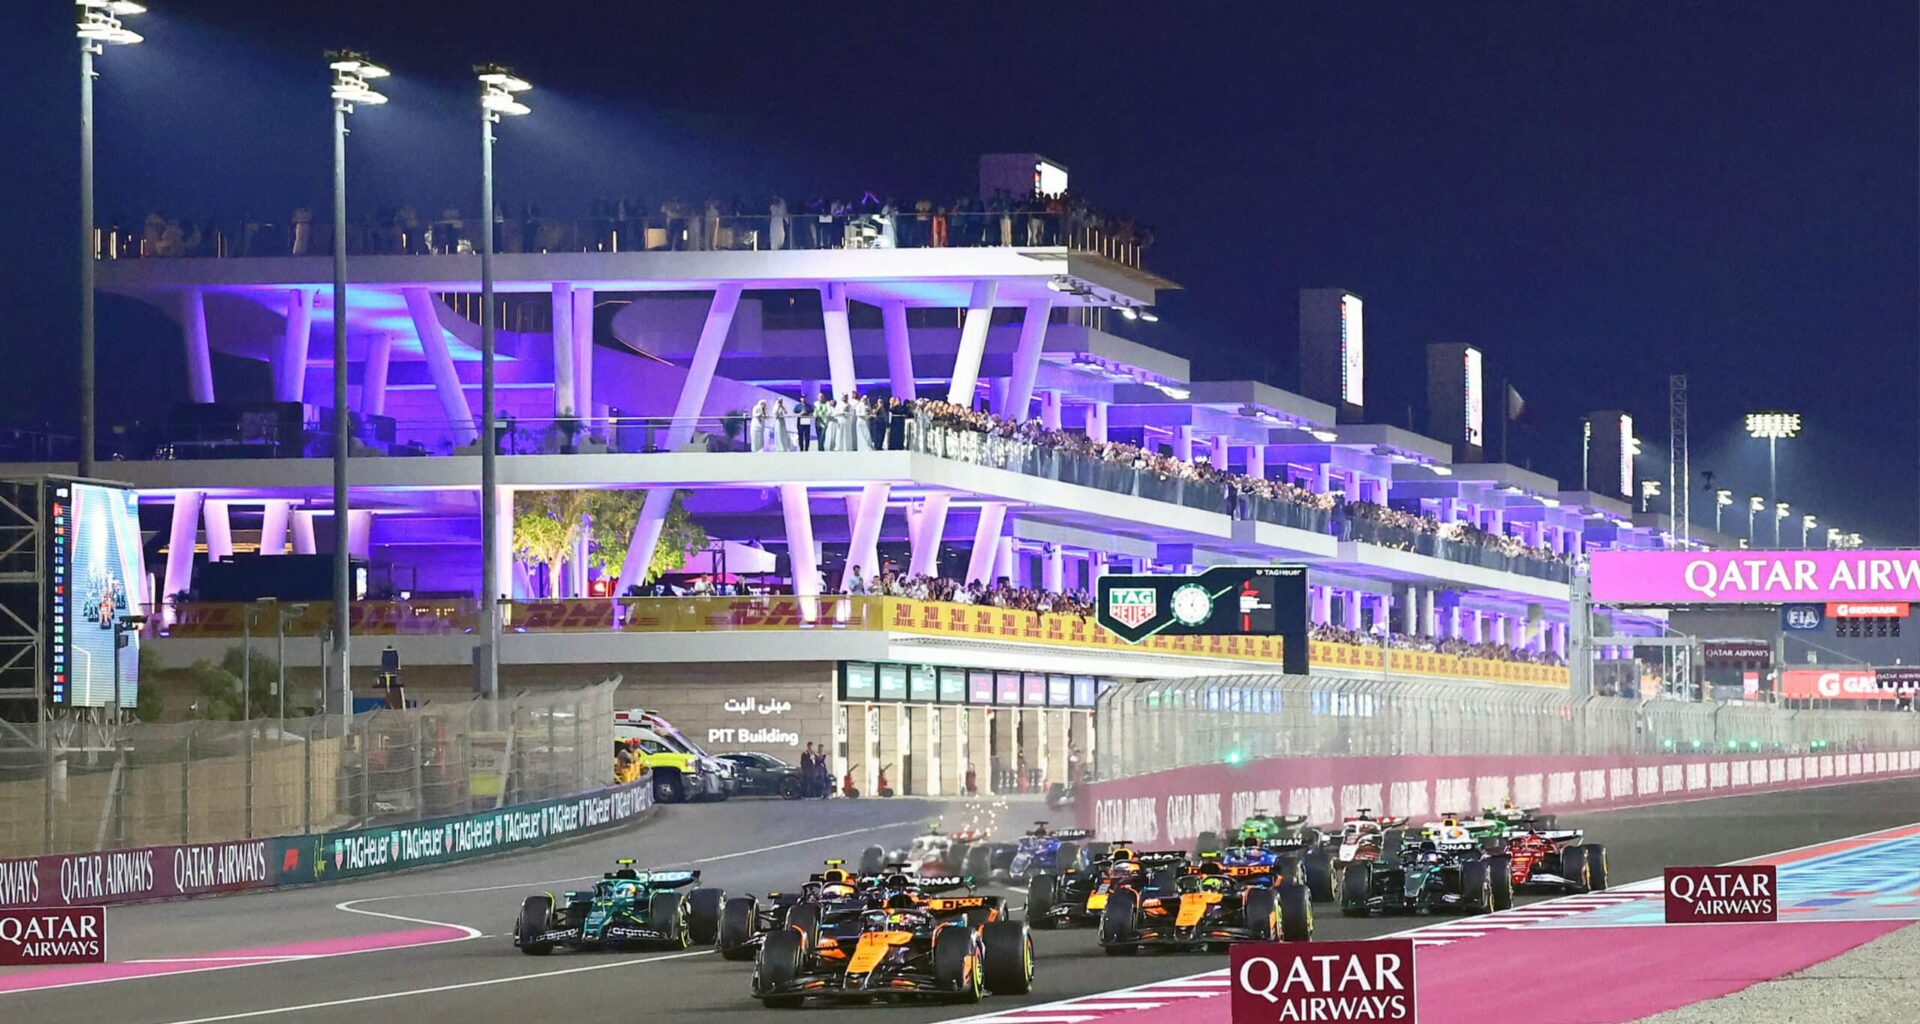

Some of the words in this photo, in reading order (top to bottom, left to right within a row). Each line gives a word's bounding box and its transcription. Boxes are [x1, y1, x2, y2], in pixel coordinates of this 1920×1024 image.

[1685, 560, 1819, 598] QATAR
[1829, 560, 1920, 590] AIRW
[1113, 591, 1152, 604] TAG
[1111, 606, 1155, 625] HEUER
[1790, 611, 1816, 624] FIA
[1706, 649, 1733, 657] QATAR
[758, 698, 791, 714] مبنى
[708, 729, 735, 743] PIT
[738, 728, 799, 746] Building
[345, 836, 389, 869] TAGHeuer
[401, 824, 444, 859] TAGHeuer
[454, 817, 494, 852] TAGHeuer
[504, 810, 541, 843] TAGHeuer
[0, 860, 39, 905] RWAYS
[61, 856, 102, 904] QATAR
[106, 850, 153, 895] AIRWAYS
[174, 847, 215, 892] QATAR
[216, 842, 266, 885] AIRWAYS
[1670, 873, 1771, 903] QATAR
[1694, 899, 1772, 915] AIRWAYS
[0, 915, 98, 945] QATAR
[22, 941, 99, 957] AIRWAYS
[1240, 953, 1404, 1003] QATAR
[1279, 995, 1406, 1022] AIRWAYS
